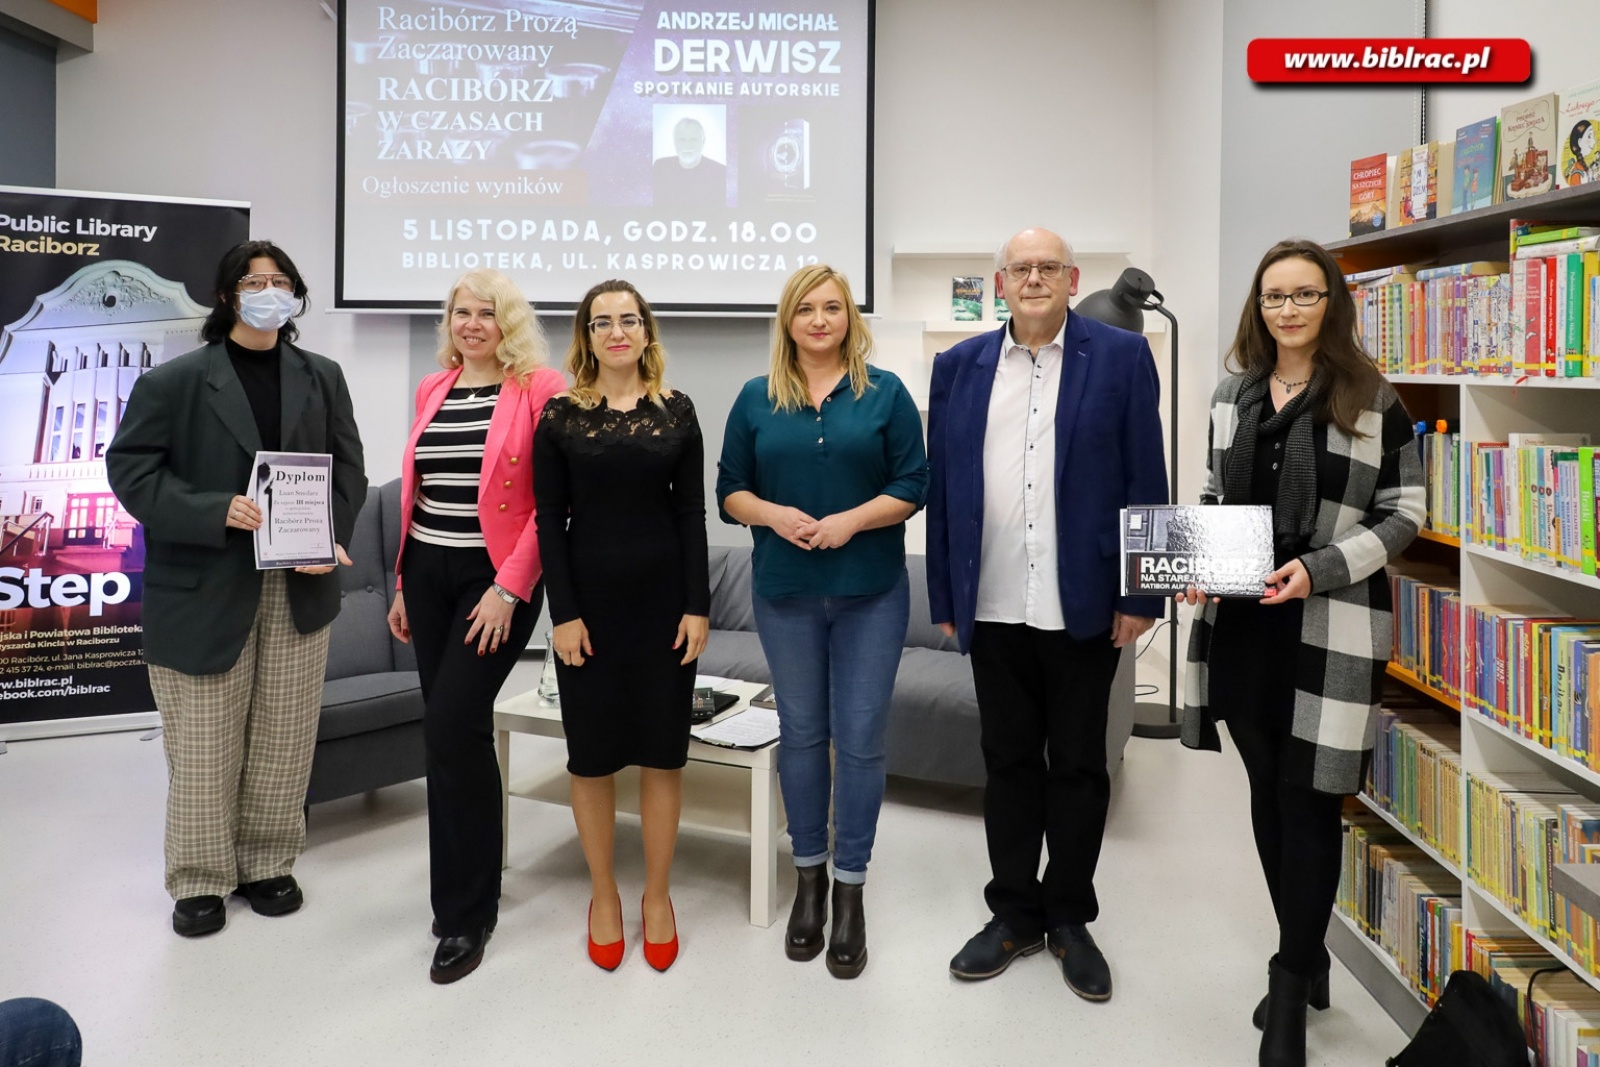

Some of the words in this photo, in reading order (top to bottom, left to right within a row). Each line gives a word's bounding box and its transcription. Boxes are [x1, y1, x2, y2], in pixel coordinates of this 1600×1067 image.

[377, 6, 496, 32] Racibórz
[504, 8, 579, 39] Prozą
[656, 11, 754, 30] ANDRZEJ
[758, 12, 839, 31] MICHAŁ
[377, 35, 554, 68] Zaczarowany
[377, 72, 554, 102] RACIBÓRZ
[633, 80, 734, 96] SPOTKANIE
[739, 82, 840, 97] AUTORSKIE
[377, 110, 404, 131] W
[410, 111, 544, 132] CZASACH
[377, 139, 492, 160] ZARAZY
[362, 175, 470, 198] Ogłoszenie
[476, 176, 563, 198] wyników
[0, 213, 70, 234] Public
[76, 217, 158, 242] Library
[403, 219, 418, 240] 5
[430, 219, 612, 246] LISTOPADA,
[623, 220, 717, 243] GODZ.
[0, 235, 100, 256] Raciborz
[402, 252, 552, 272] BIBLIOTEKA,
[562, 252, 597, 270] UL.
[607, 253, 787, 271] KASPROWICZA
[276, 470, 325, 485] Dyplom
[1581, 490, 1591, 523] Bratki
[1140, 574, 1155, 582] NA
[1158, 574, 1196, 582] STAREJ
[0, 566, 131, 617] Step
[0, 641, 36, 651] yszarda
[37, 639, 65, 648] Kincla
[76, 637, 120, 646] Raciborzu
[30, 628, 91, 639] Powiatowa
[63, 653, 83, 661] Jana
[84, 650, 136, 661] Kasprowicza
[6, 666, 20, 674] 415
[21, 665, 31, 673] 37
[46, 663, 75, 671] e-mail:
